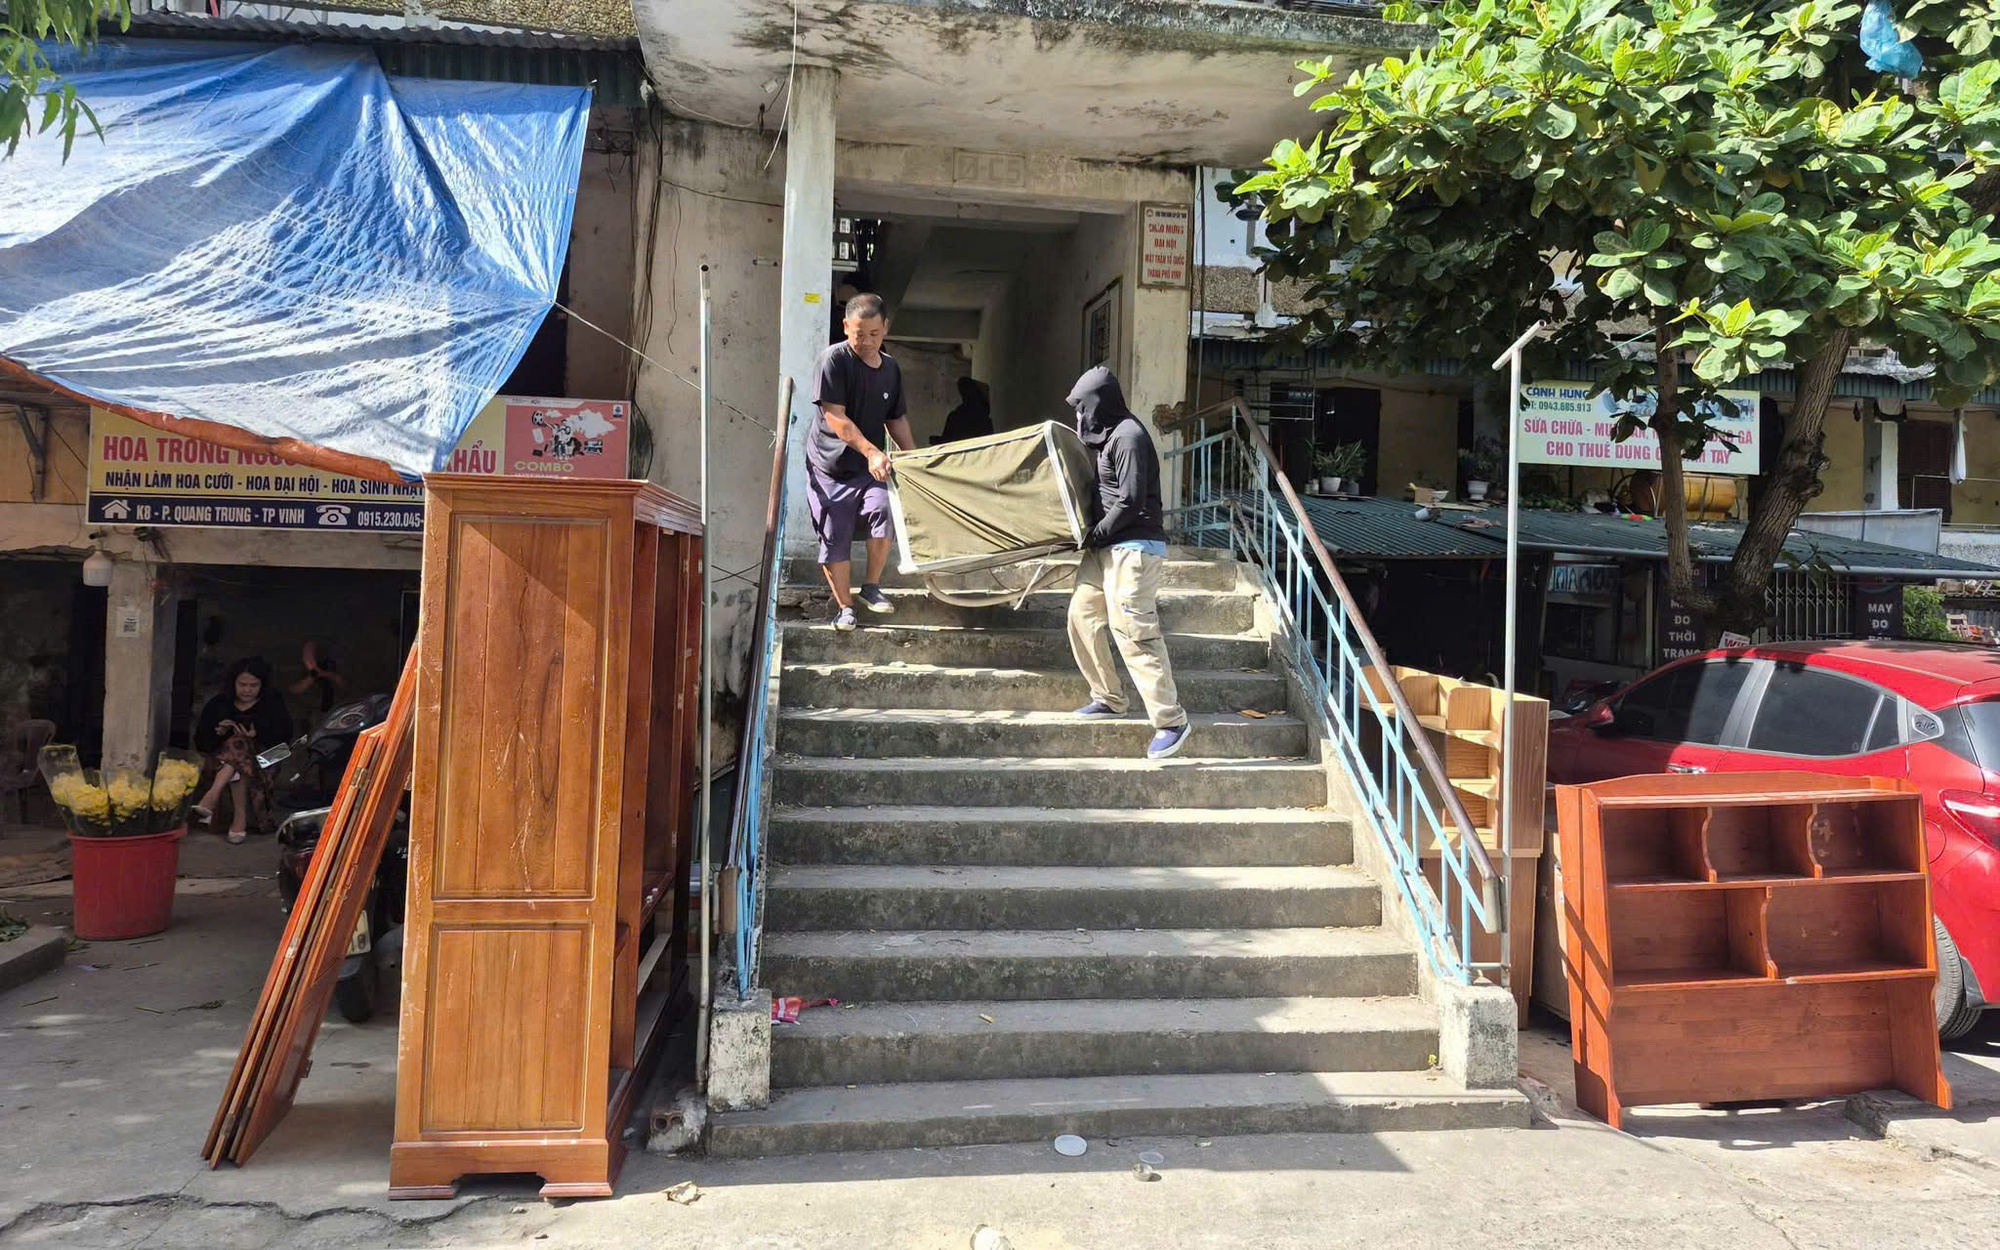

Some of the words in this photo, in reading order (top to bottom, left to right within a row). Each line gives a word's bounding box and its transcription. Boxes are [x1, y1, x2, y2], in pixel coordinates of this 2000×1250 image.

[1539, 401, 1592, 413] 0943.685.913
[1524, 416, 1547, 434] SỬA
[1551, 419, 1583, 435] CHỮA
[103, 435, 149, 463] HOA
[447, 439, 497, 474] HẨU
[1546, 440, 1574, 457] CHO
[1578, 441, 1611, 459] THUÊ
[1615, 444, 1651, 463] DỤNG
[1711, 449, 1731, 465] TAY
[514, 460, 575, 473] COMBO
[105, 469, 141, 491] NHẬN
[145, 469, 172, 488] LÀM
[176, 474, 201, 489] HOA
[204, 471, 234, 490] CƯỚI
[246, 475, 271, 491] HOA
[274, 476, 295, 495] ĐẠI
[299, 474, 320, 496] HỘI
[332, 478, 356, 494] HOA
[360, 479, 389, 495] SINH
[136, 504, 151, 521] K8
[161, 505, 172, 521] P.
[174, 506, 213, 523] QUANG
[214, 506, 251, 523] TRUNG
[262, 507, 276, 524] TP
[278, 508, 305, 525] VINH
[1868, 603, 1893, 613] MAY
[1871, 619, 1889, 629] ĐO
[1668, 630, 1696, 642] THỜI
